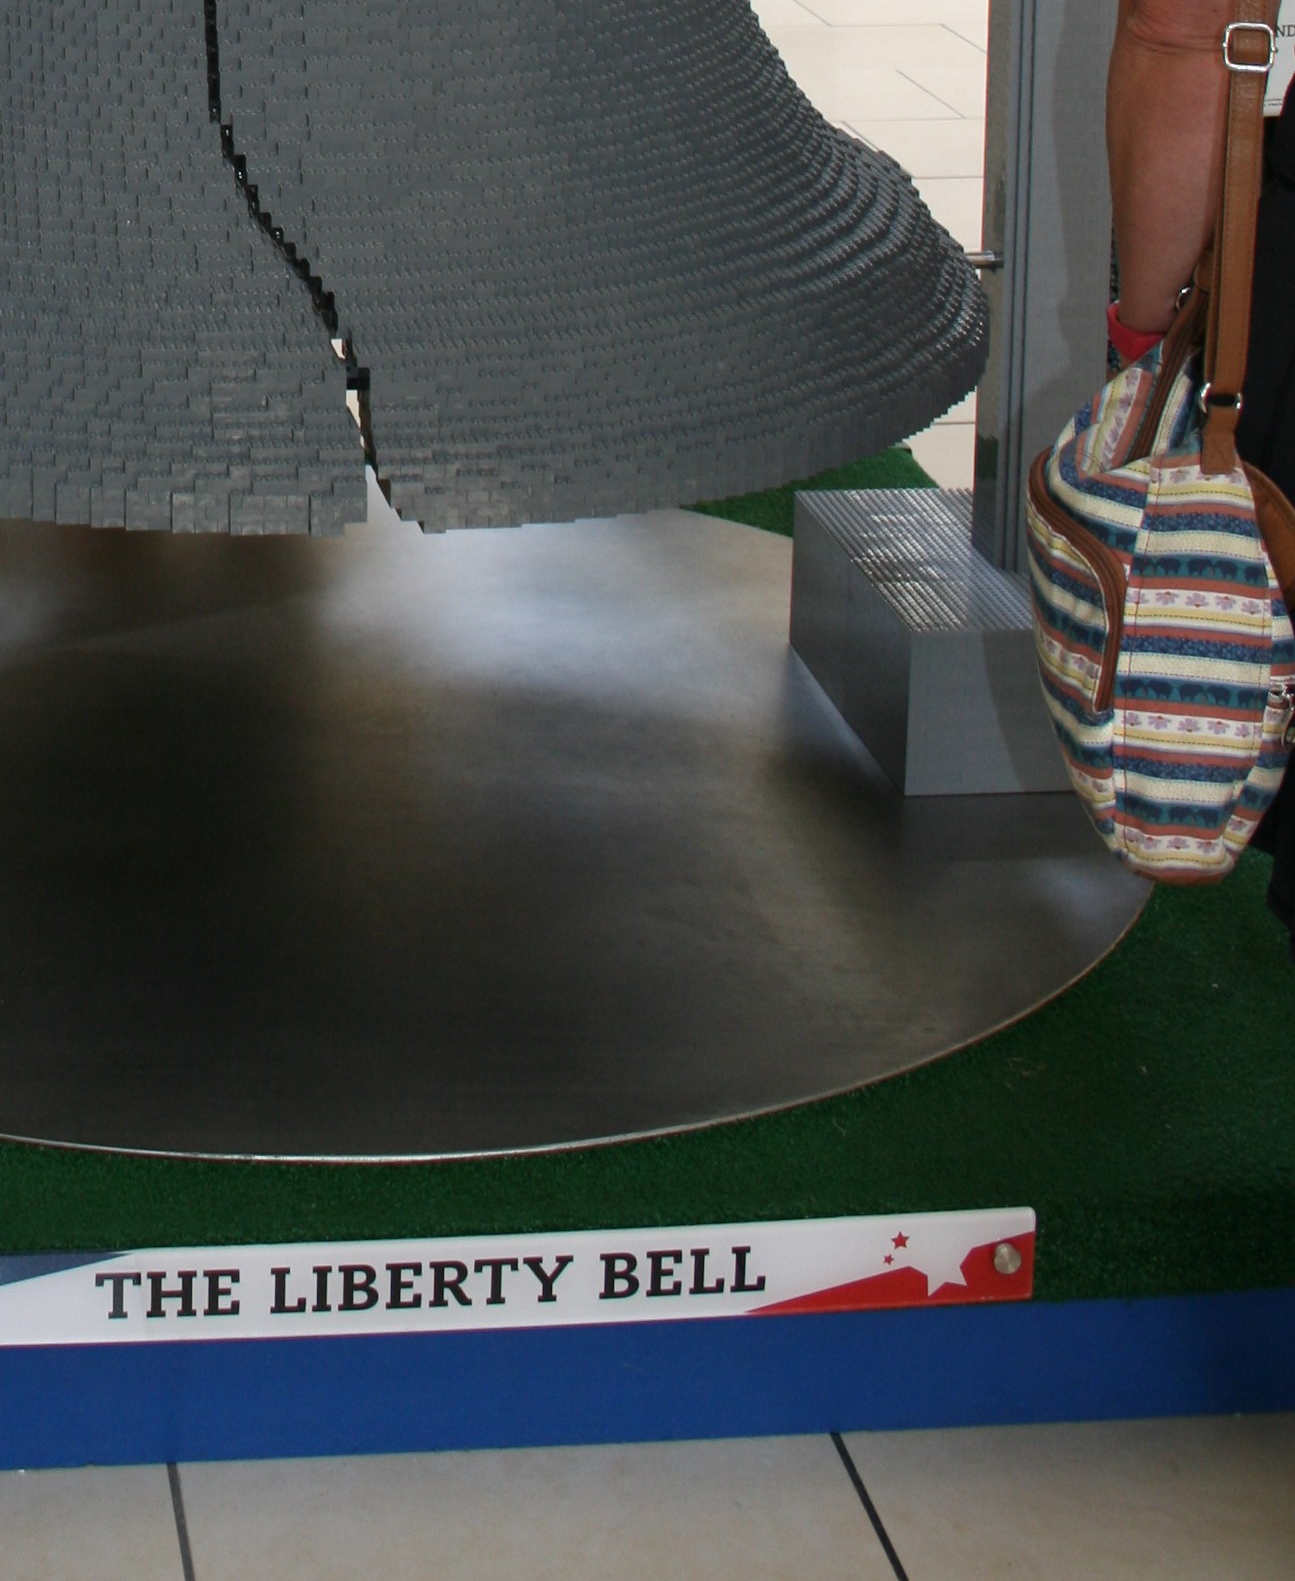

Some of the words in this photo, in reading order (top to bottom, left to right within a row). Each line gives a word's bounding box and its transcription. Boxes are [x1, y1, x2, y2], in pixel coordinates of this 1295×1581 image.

[95, 1268, 241, 1319] THE
[269, 1254, 574, 1314] LIBERTY
[599, 1245, 767, 1300] BELL
